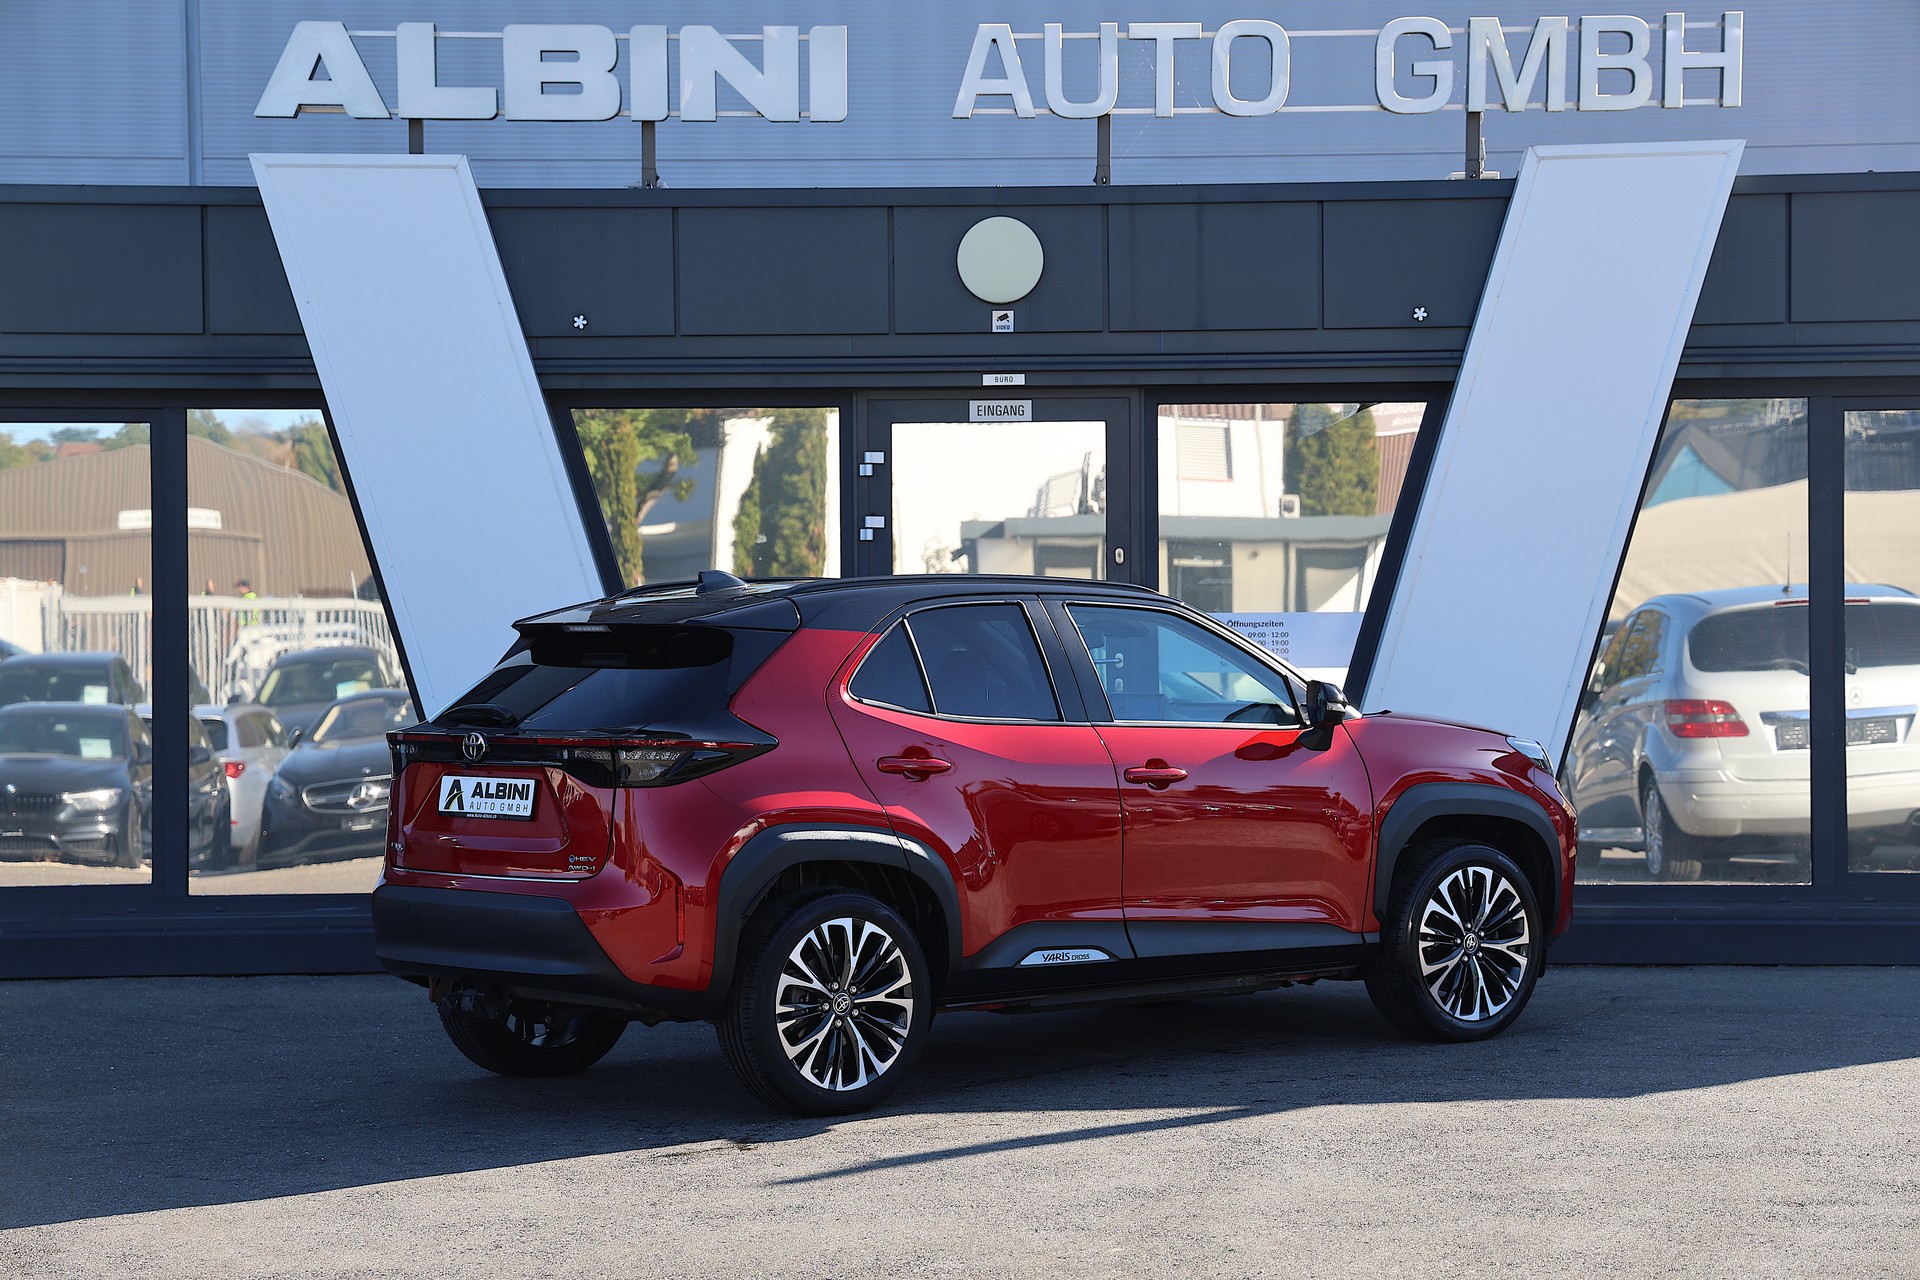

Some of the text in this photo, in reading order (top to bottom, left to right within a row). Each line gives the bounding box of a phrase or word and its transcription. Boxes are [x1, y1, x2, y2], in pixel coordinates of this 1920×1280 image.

[254, 10, 1743, 122] ALBINI AUTO GMBH
[994, 375, 1014, 383] BÜRO
[977, 405, 1025, 417] EINGANG
[1226, 619, 1284, 628] Öffnungszeiten
[470, 781, 531, 801] ALBINI
[468, 801, 529, 813] AUTO GMBH
[1042, 952, 1090, 962] YARIS CROSS
